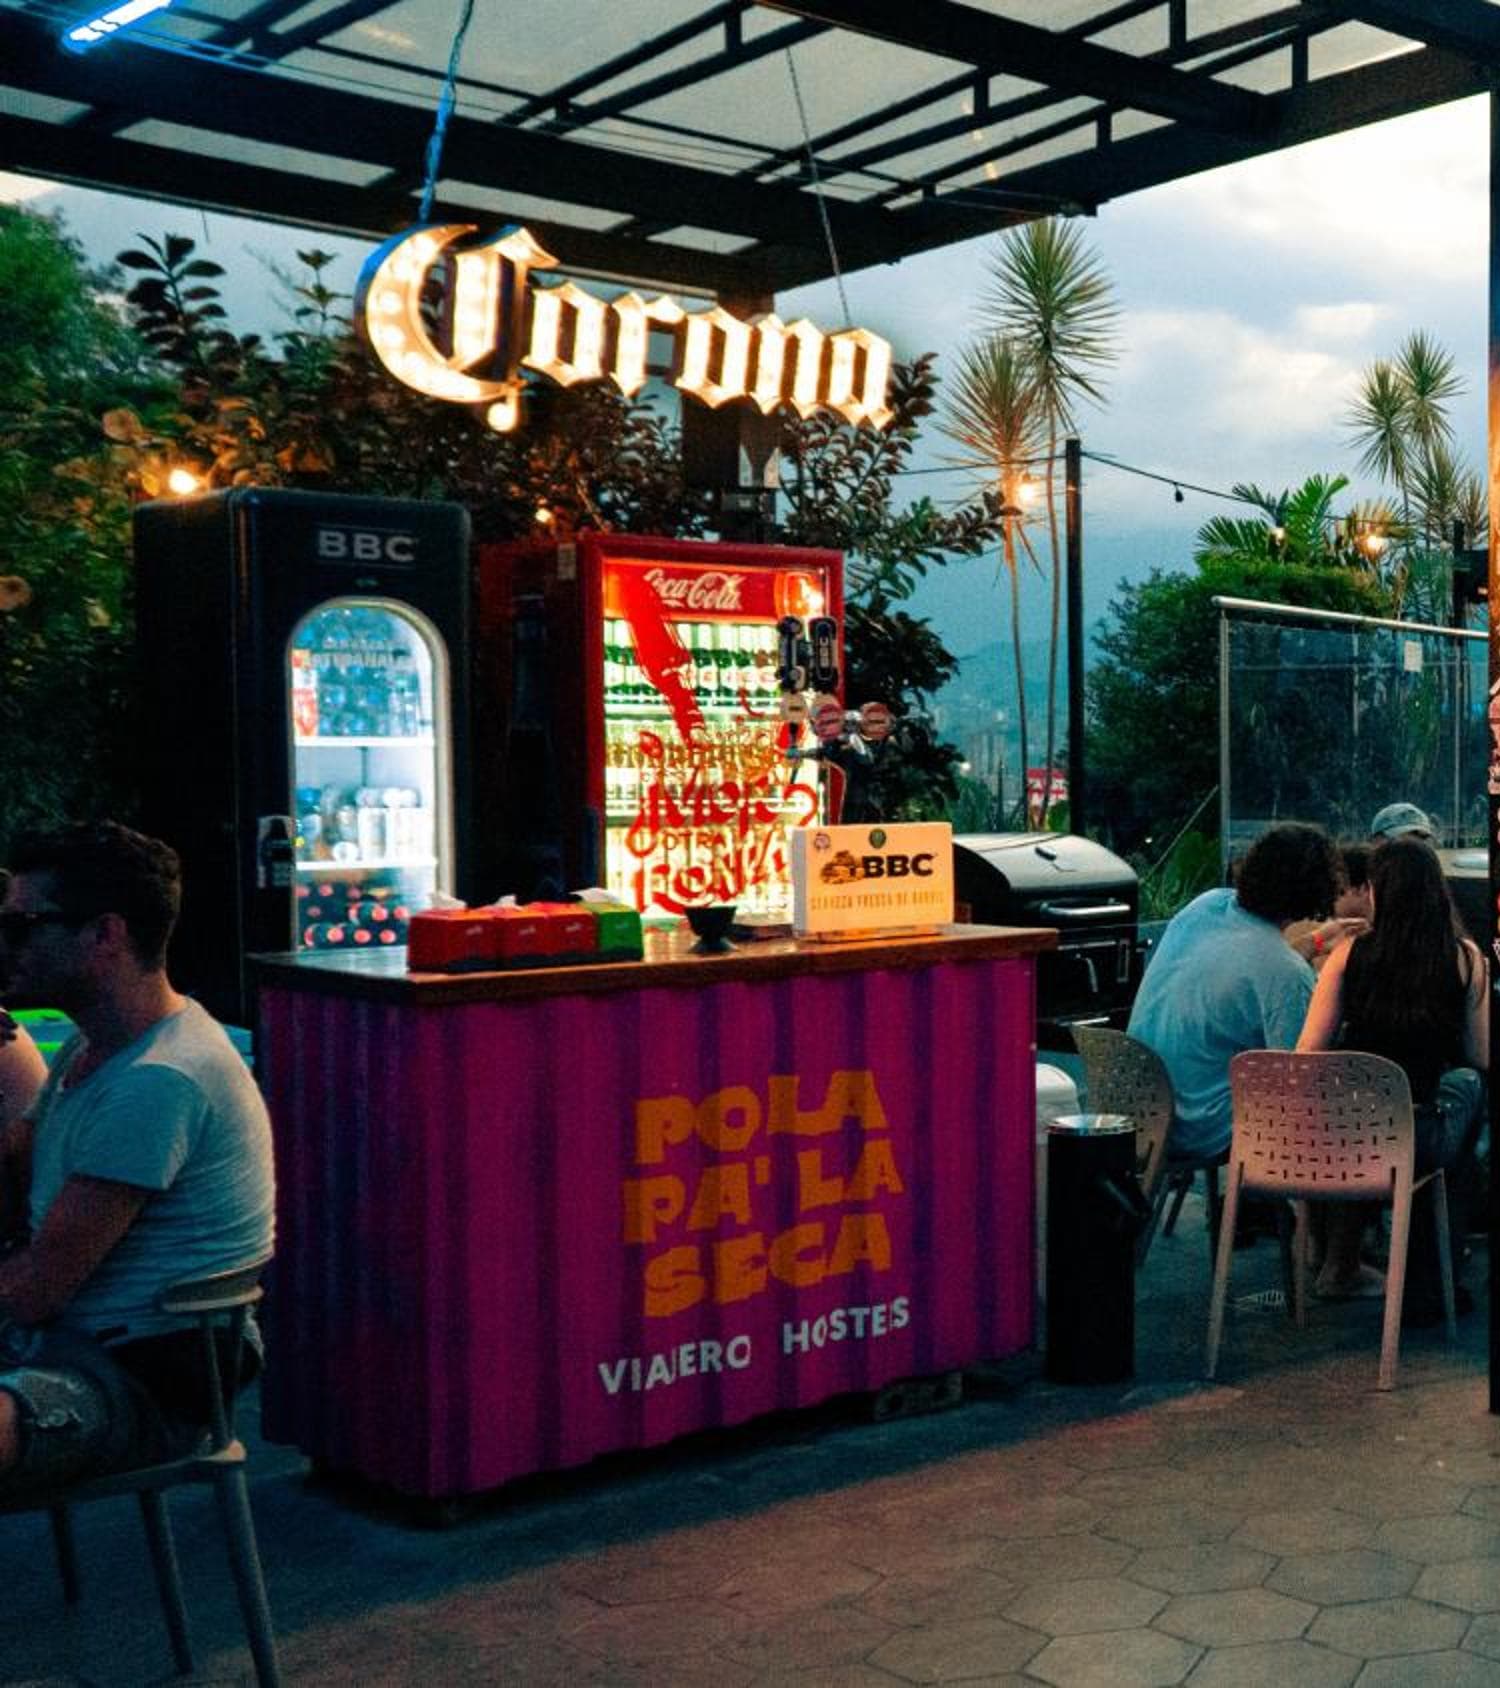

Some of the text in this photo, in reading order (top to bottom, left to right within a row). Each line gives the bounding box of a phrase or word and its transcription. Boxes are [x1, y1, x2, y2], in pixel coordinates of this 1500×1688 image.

[357, 223, 894, 432] Corona
[318, 530, 416, 562] BBC
[643, 568, 746, 610] Coca-Cola
[861, 853, 936, 879] BBC
[634, 1070, 889, 1165] POLA
[797, 1138, 904, 1212] LA
[644, 1213, 892, 1317] SECA
[598, 1335, 751, 1395] VIAJERO
